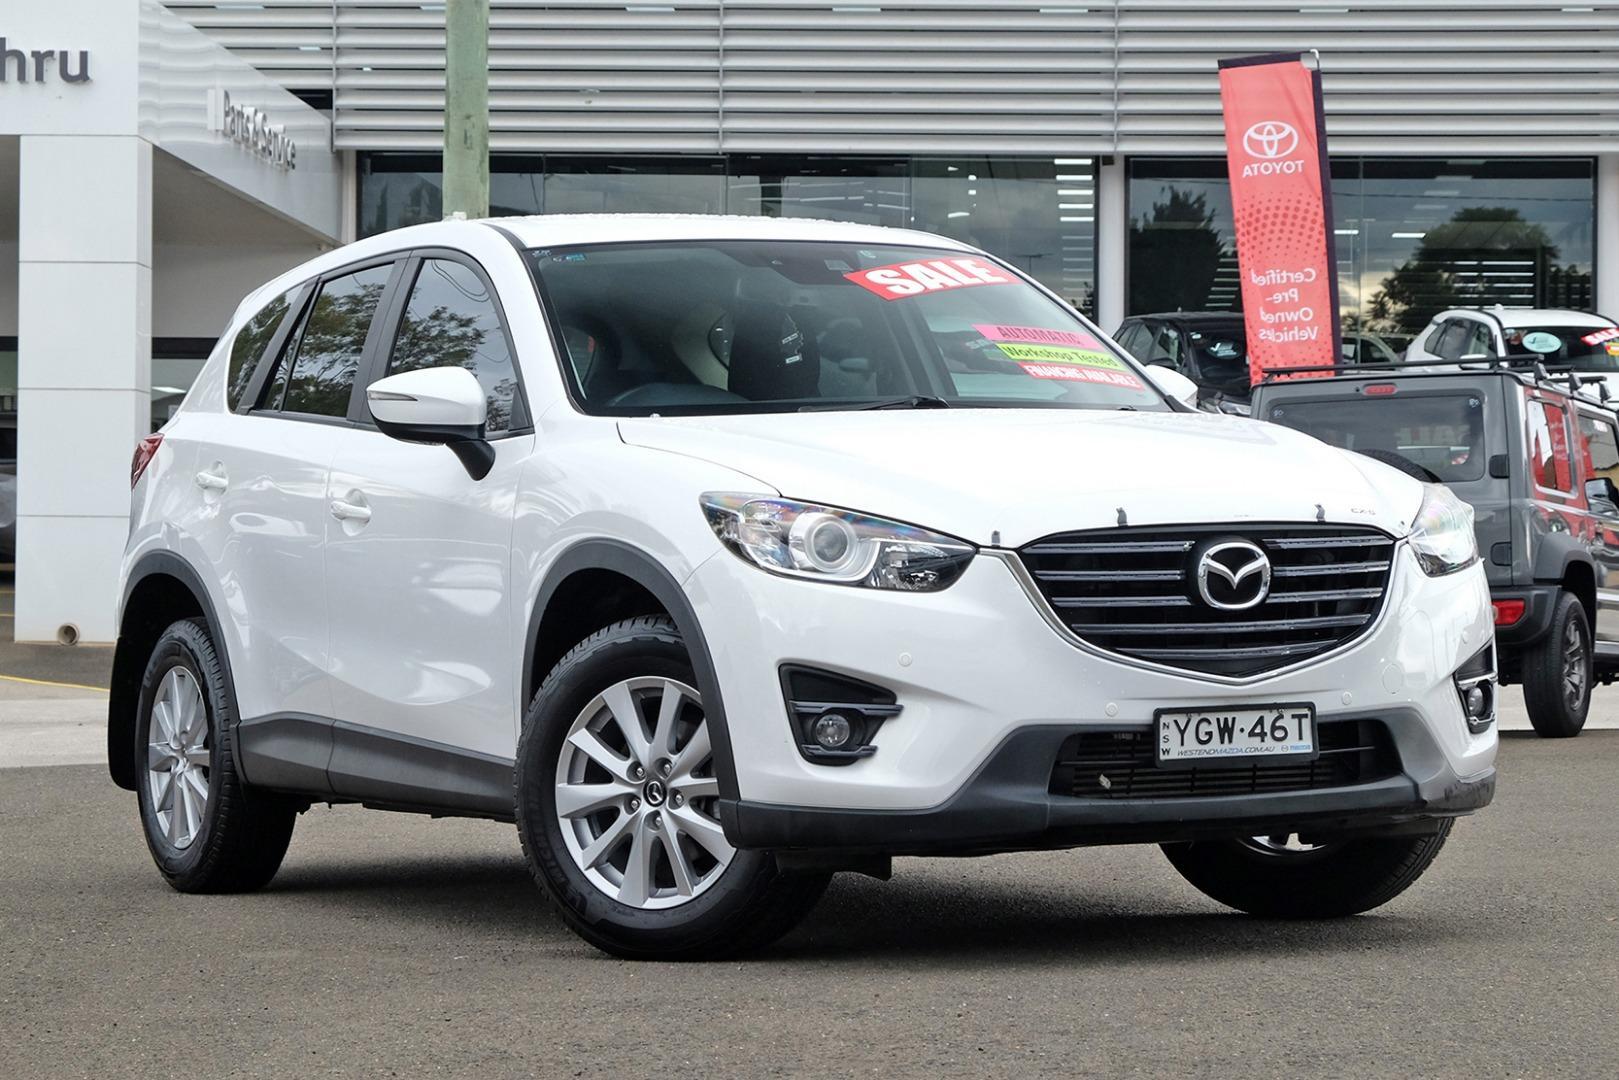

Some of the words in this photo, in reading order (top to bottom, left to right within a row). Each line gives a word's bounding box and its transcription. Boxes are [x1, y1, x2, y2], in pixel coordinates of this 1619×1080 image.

[0, 37, 90, 83] hru
[865, 258, 1009, 295] SALE
[997, 327, 1082, 345] AUTOMATIC
[1002, 346, 1074, 361] Workshop
